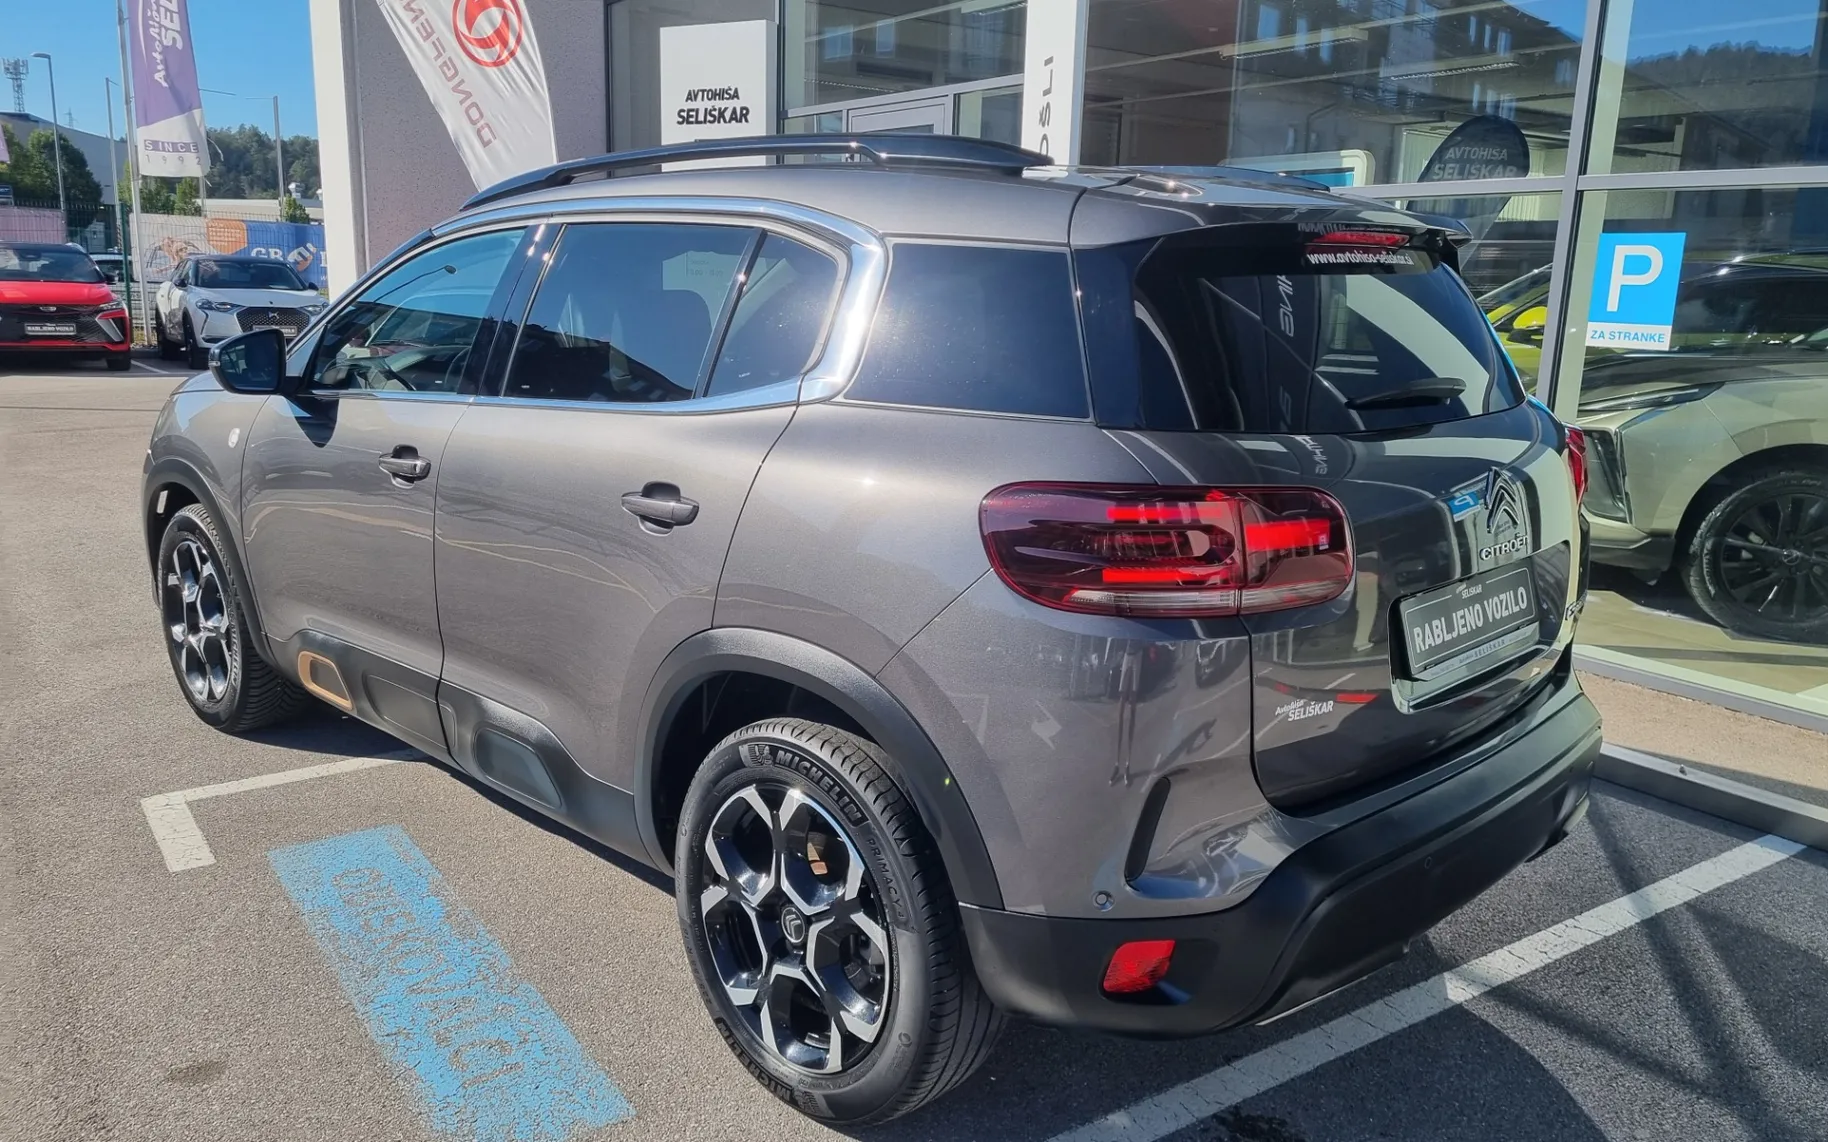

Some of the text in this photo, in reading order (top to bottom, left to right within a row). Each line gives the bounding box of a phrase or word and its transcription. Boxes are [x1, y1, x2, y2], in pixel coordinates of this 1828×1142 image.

[685, 86, 740, 102] AVTOHIŠA
[677, 105, 750, 125] SELIŠKAR
[145, 140, 198, 152] SINCE
[146, 154, 201, 166] 1992
[1606, 245, 1664, 312] P
[1590, 330, 1665, 343] ZA STRANKE
[1413, 603, 1484, 653] RABLJENO
[1484, 586, 1528, 623] VOZILO
[1288, 700, 1334, 721] SELIŠKAR
[775, 750, 863, 823] MICHELIN
[866, 837, 903, 908] PRIMACY
[717, 1020, 795, 1100] MICHELIN
